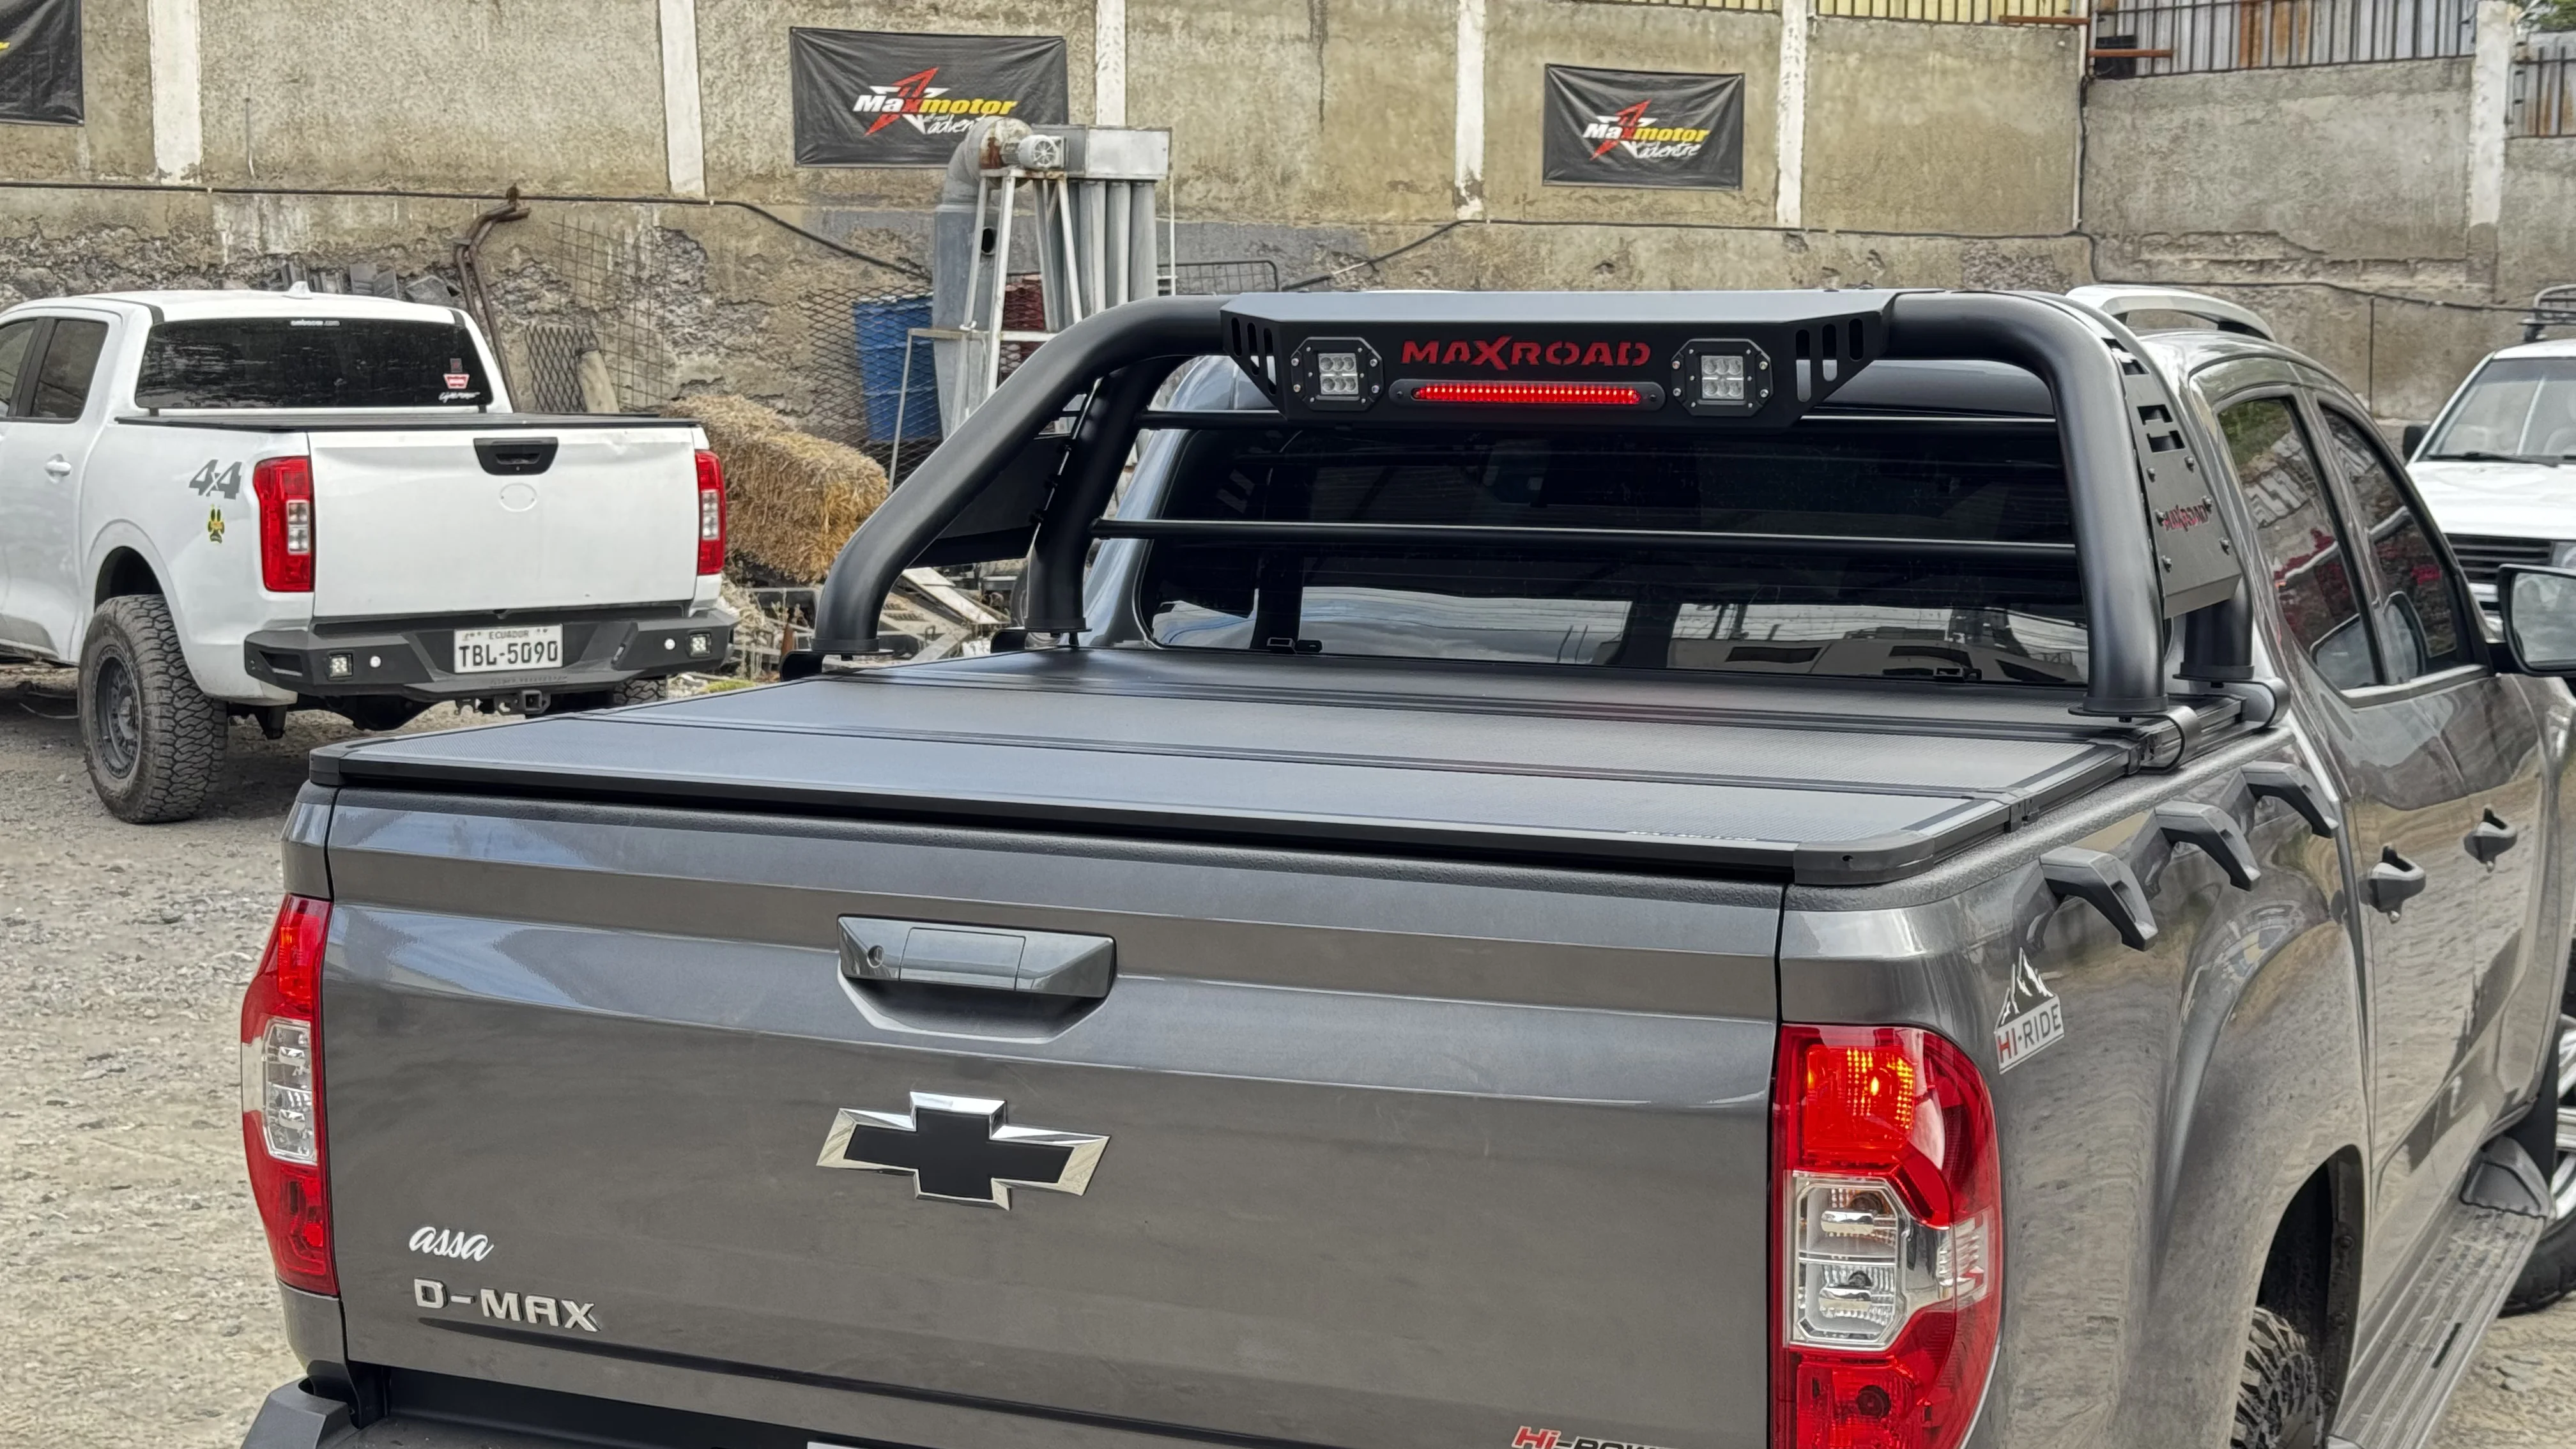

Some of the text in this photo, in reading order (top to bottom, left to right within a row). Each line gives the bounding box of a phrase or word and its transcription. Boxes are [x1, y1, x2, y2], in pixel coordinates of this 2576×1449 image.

[1400, 335, 1651, 371] MAXROAD
[489, 630, 529, 640] ECUADOR
[459, 641, 558, 667] TBL-5090
[1997, 1004, 2062, 1064] HI-RIDE
[409, 1226, 494, 1262] assa
[414, 1277, 601, 1333] D-MAX
